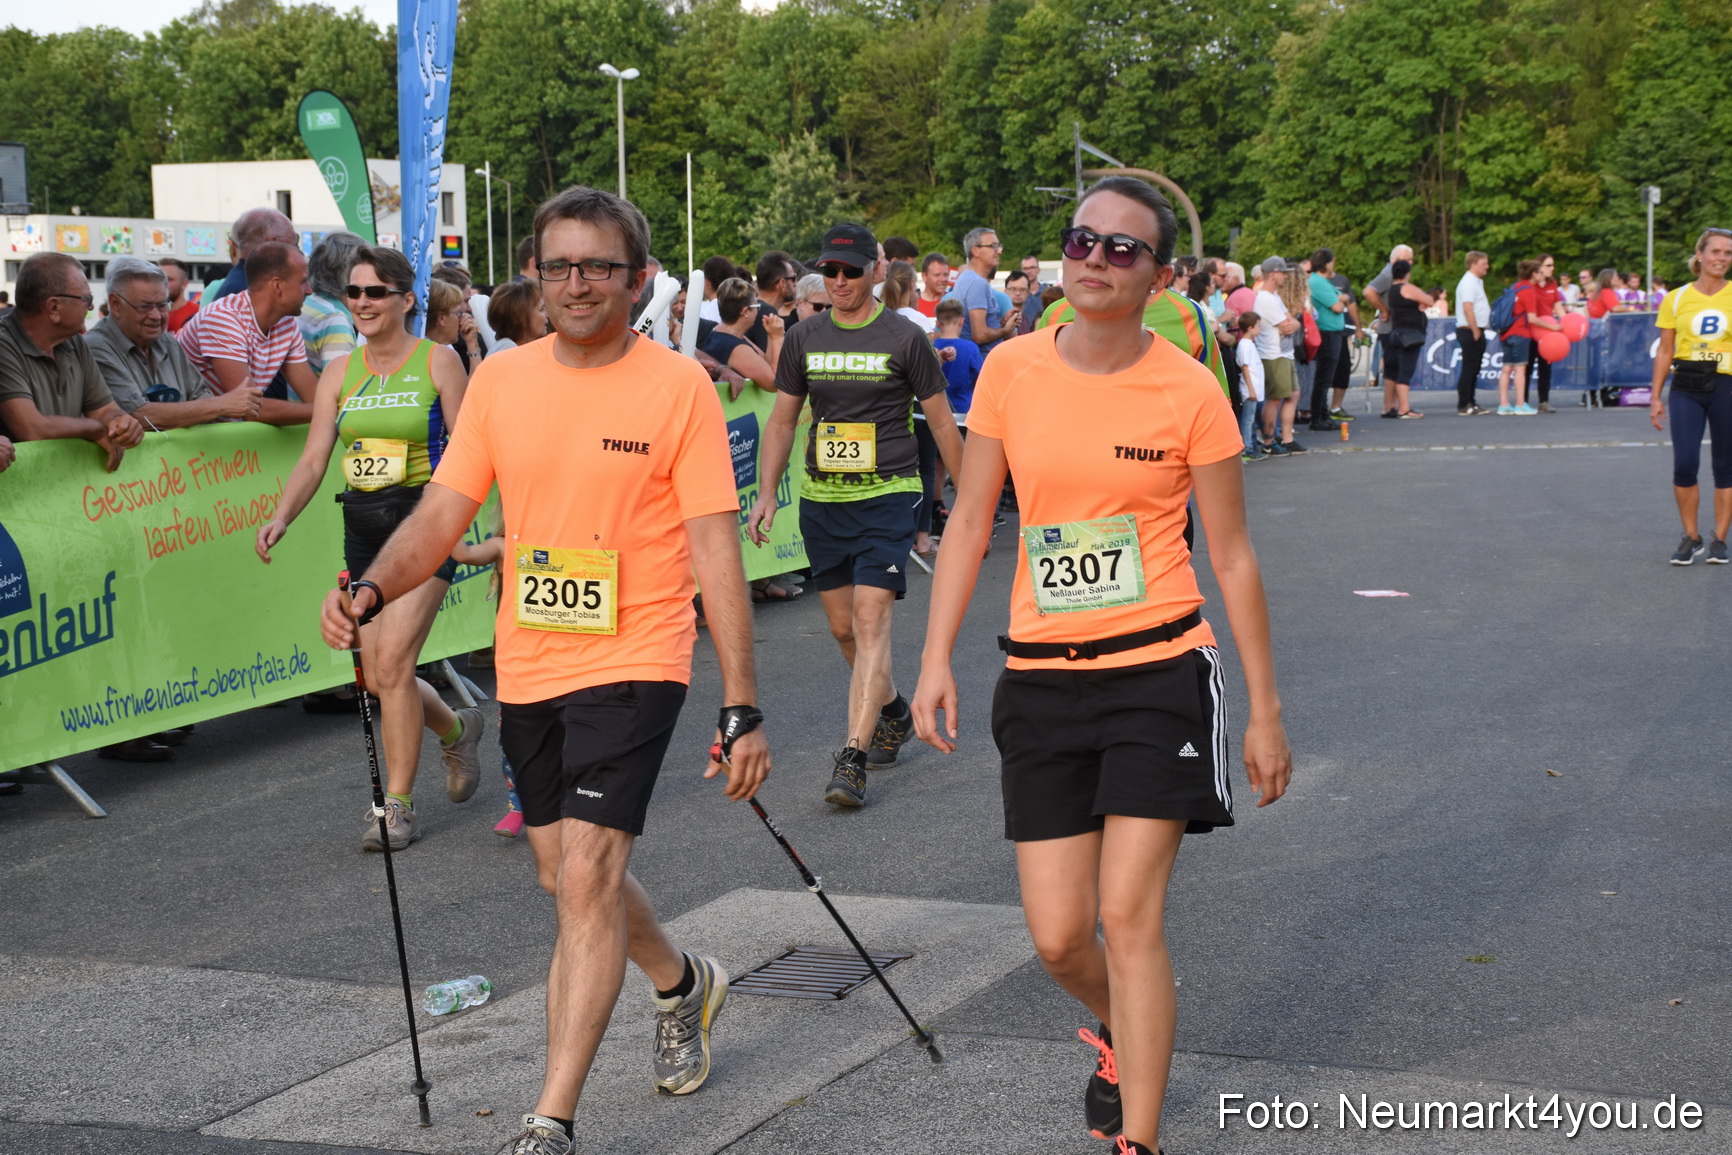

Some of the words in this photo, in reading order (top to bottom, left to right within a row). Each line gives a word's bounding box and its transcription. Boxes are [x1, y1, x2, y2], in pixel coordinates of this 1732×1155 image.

[1700, 316, 1719, 335] B
[807, 353, 890, 373] BOCK
[827, 373, 836, 381] by
[343, 392, 420, 411] BOCK
[602, 438, 650, 455] THULE
[826, 441, 860, 458] 323
[1114, 446, 1165, 462] THULE
[353, 458, 388, 477] 322
[83, 457, 187, 522] Gesunde
[188, 449, 262, 490] Firmen
[144, 507, 214, 560] laufen
[1108, 539, 1131, 548] 2019
[1039, 549, 1122, 588] 2307
[524, 575, 602, 610] 2305
[1050, 587, 1086, 598] Neßlauer
[1089, 584, 1121, 595] Sabina
[1083, 595, 1103, 603] GmbH
[525, 606, 570, 618] Moosburger
[572, 610, 601, 619] Tobias
[61, 643, 312, 733] www.firmenlauf-oberpfalz.de
[576, 787, 604, 799] benger
